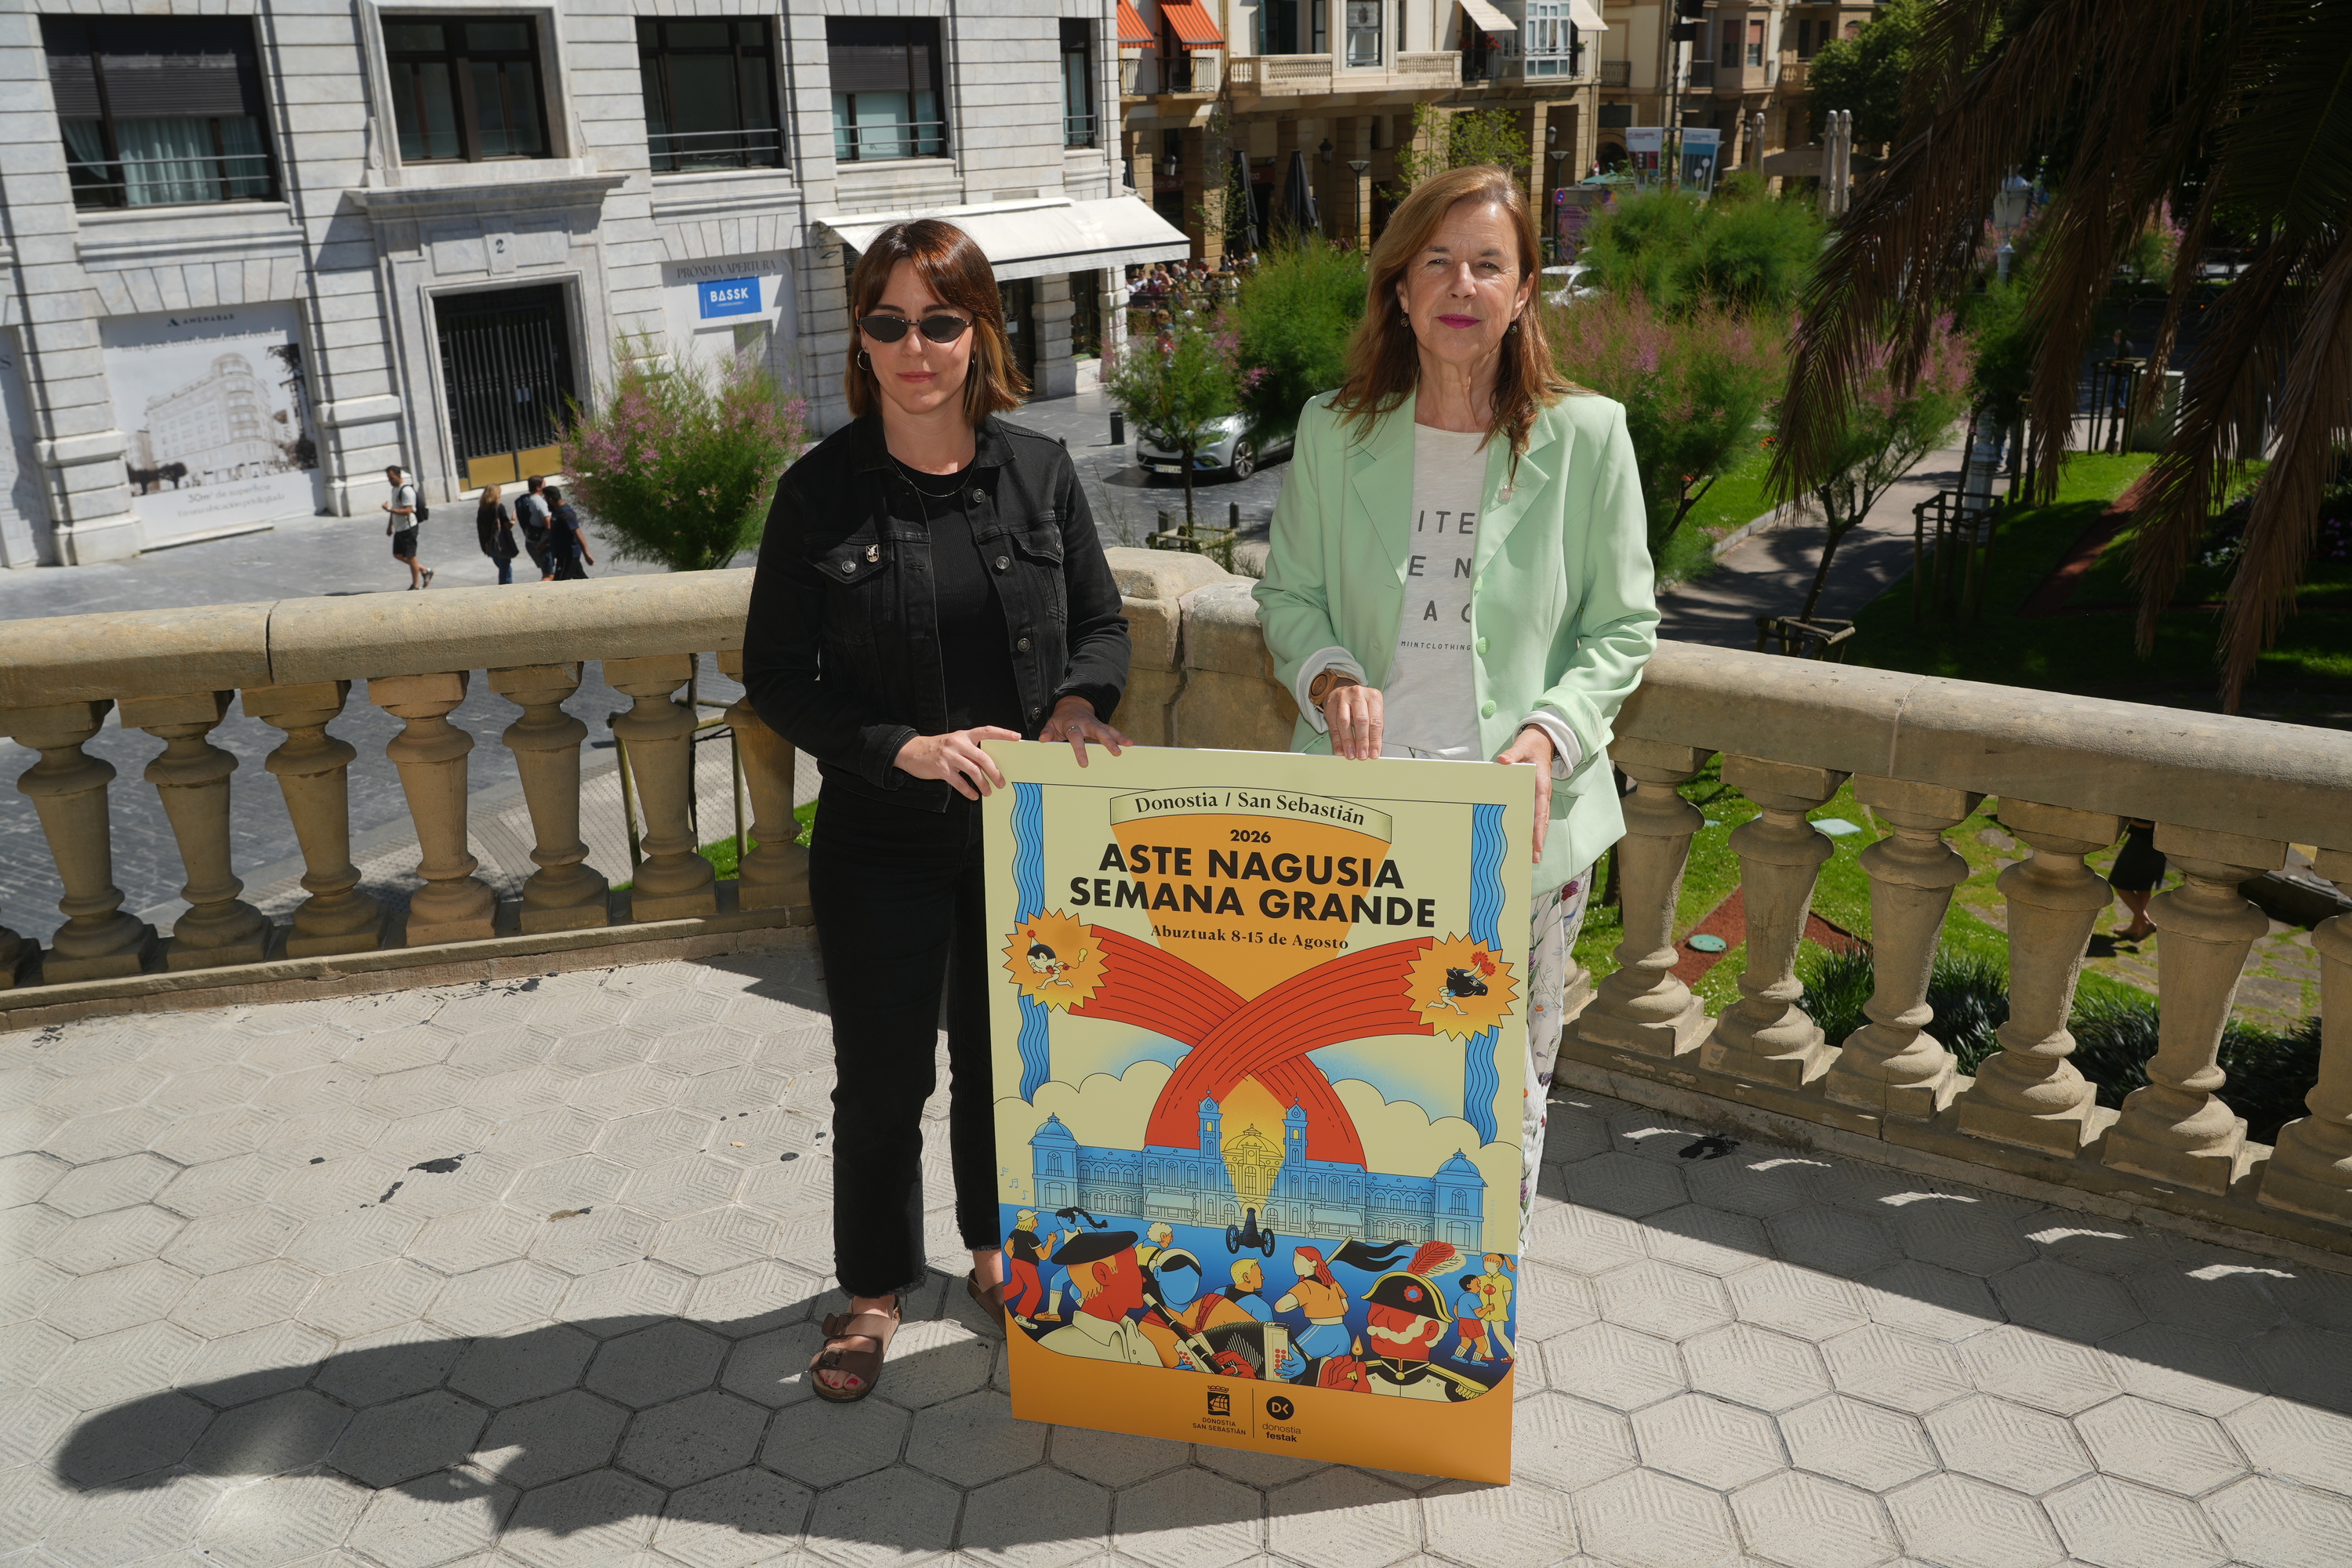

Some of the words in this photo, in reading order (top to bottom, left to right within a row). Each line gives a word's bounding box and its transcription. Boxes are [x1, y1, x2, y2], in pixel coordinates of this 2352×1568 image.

[495, 238, 505, 254] 2
[677, 264, 724, 279] PRÓXIMA
[725, 260, 777, 274] APERTURA
[710, 287, 749, 303] BASSK
[215, 489, 227, 499] de
[1135, 792, 1218, 813] Donostia
[1225, 792, 1231, 808] /
[1238, 792, 1272, 809] San
[1276, 794, 1365, 826] Sebastián
[1230, 829, 1272, 844] 2026
[1098, 843, 1192, 877] ASTE
[1209, 849, 1404, 889] NAGUSIA
[1069, 877, 1245, 916] SEMANA
[1258, 889, 1436, 928] GRANDE
[1151, 924, 1226, 942] Abuztuak
[1231, 931, 1264, 944] 8-15
[1269, 932, 1287, 946] de
[1291, 934, 1348, 950] Agosto
[1202, 1417, 1236, 1427] DONOSTIA
[1261, 1422, 1301, 1435] donostia
[1208, 1425, 1247, 1436] SEBASTIÁN
[1266, 1432, 1298, 1443] festak
